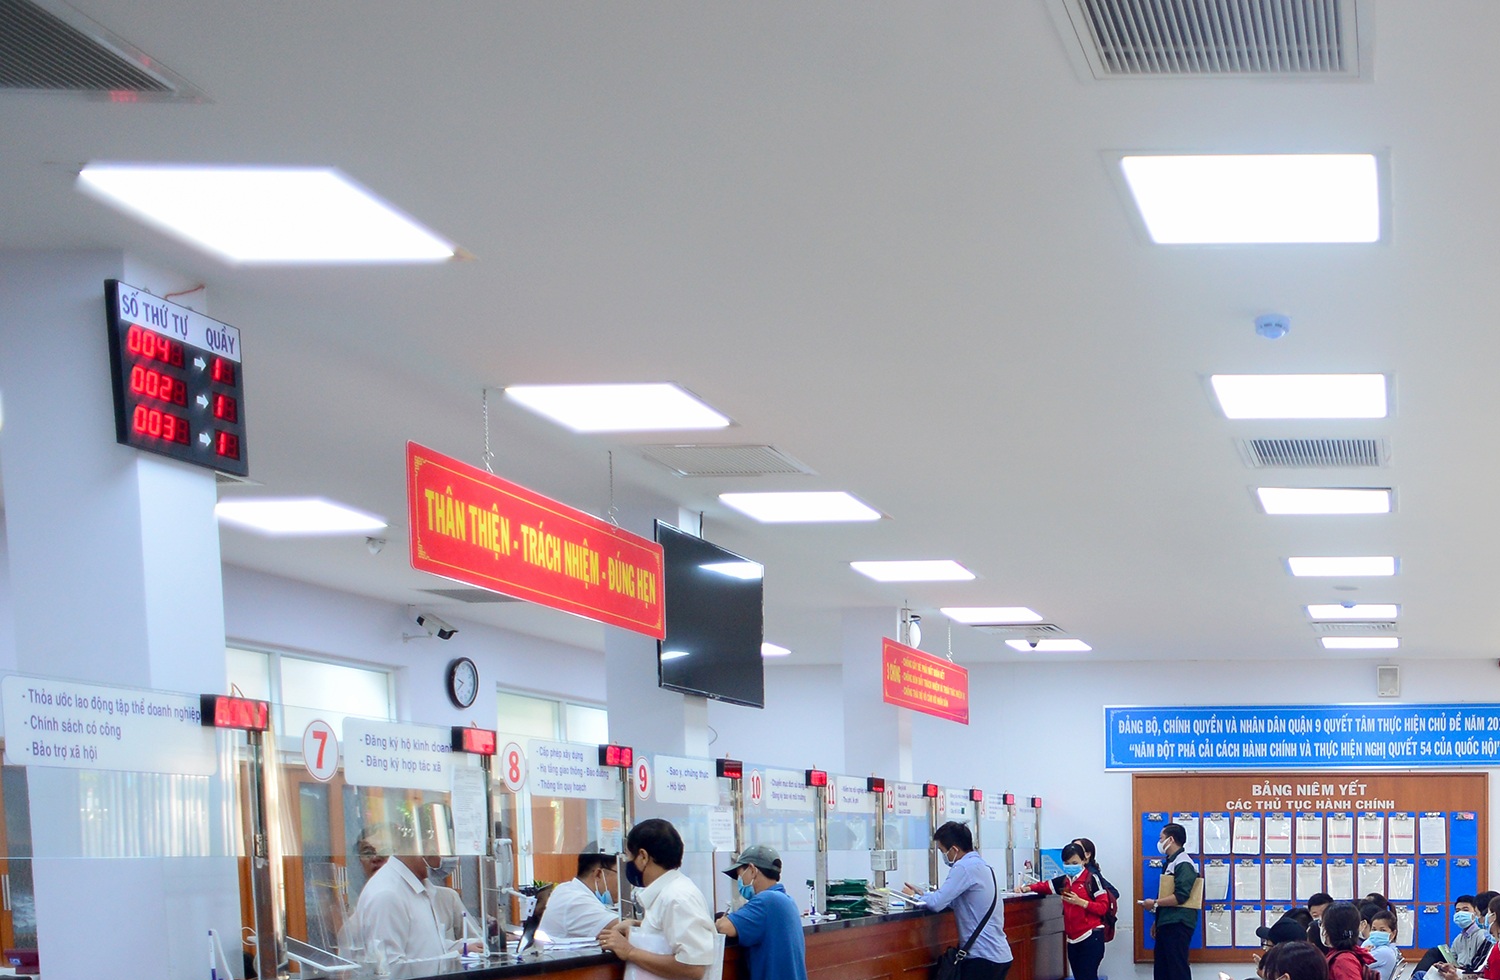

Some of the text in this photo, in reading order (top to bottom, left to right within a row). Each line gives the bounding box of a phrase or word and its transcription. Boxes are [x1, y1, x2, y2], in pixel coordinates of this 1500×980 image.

[122, 291, 235, 354] SỐ THỨ TỰ QUẦY
[425, 485, 466, 541] THÂN
[468, 503, 511, 560] THIỆN
[520, 521, 562, 573] TRÁCH
[563, 538, 600, 590] NHIỆM
[608, 551, 635, 598] ĐÚNG
[636, 566, 657, 609] HẸN
[28, 688, 53, 706] Thỏa
[55, 691, 73, 707] ước
[75, 692, 89, 709] lao
[91, 695, 114, 714] động
[116, 698, 130, 715] tập
[132, 698, 145, 715] thể
[147, 704, 173, 719] doanh
[174, 707, 201, 724] nghiệp
[30, 715, 60, 732] Chính
[61, 719, 84, 735] sách
[86, 721, 98, 736] có
[99, 722, 122, 740] công
[1118, 714, 1144, 734] ĐẢNG
[1145, 715, 1161, 736] BỘ,
[1163, 715, 1191, 734] CHÍNH
[1193, 713, 1223, 736] QUYỀN
[1225, 715, 1238, 734] VÀ
[1239, 714, 1265, 734] NHÂN
[1267, 715, 1286, 733] DÂN
[1288, 714, 1313, 736] QUẬN
[1315, 717, 1322, 733] 9
[1323, 713, 1353, 735] QUYẾT
[1355, 714, 1375, 732] TÂM
[1377, 715, 1402, 735] THỰC
[1404, 714, 1426, 734] HIỆN
[1428, 711, 1447, 732] CHỦ
[1449, 711, 1461, 731] ĐỀ
[1464, 713, 1485, 731] NĂM
[32, 740, 52, 758] Bảo
[54, 744, 67, 761] trợ
[70, 745, 81, 760] xã
[83, 744, 97, 761] hội
[312, 730, 328, 770] 7
[1156, 740, 1175, 760] ĐỘT
[1177, 740, 1196, 758] PHÁ
[1198, 738, 1214, 758] CẢI
[1215, 740, 1241, 758] CÁCH
[1242, 739, 1268, 758] HÀNH
[1269, 739, 1298, 758] CHÍNH
[1299, 739, 1312, 757] VÀ
[1314, 739, 1339, 759] THỰC
[1340, 738, 1363, 759] HIỆN
[1364, 741, 1386, 759] NGHỊ
[1388, 736, 1418, 758] QUYẾT
[1420, 741, 1432, 756] 54
[1434, 736, 1453, 756] CỦA
[1454, 736, 1479, 758] QUỐC
[419, 759, 431, 772] tác
[508, 750, 521, 784] 8
[638, 764, 648, 793] 9
[751, 775, 761, 800] 10
[1252, 779, 1368, 797] BẢNG NIÊM YẾT
[886, 789, 894, 809] 12
[1225, 797, 1395, 812] CÁC THỦ TỤC HÀNH CHÍNH
